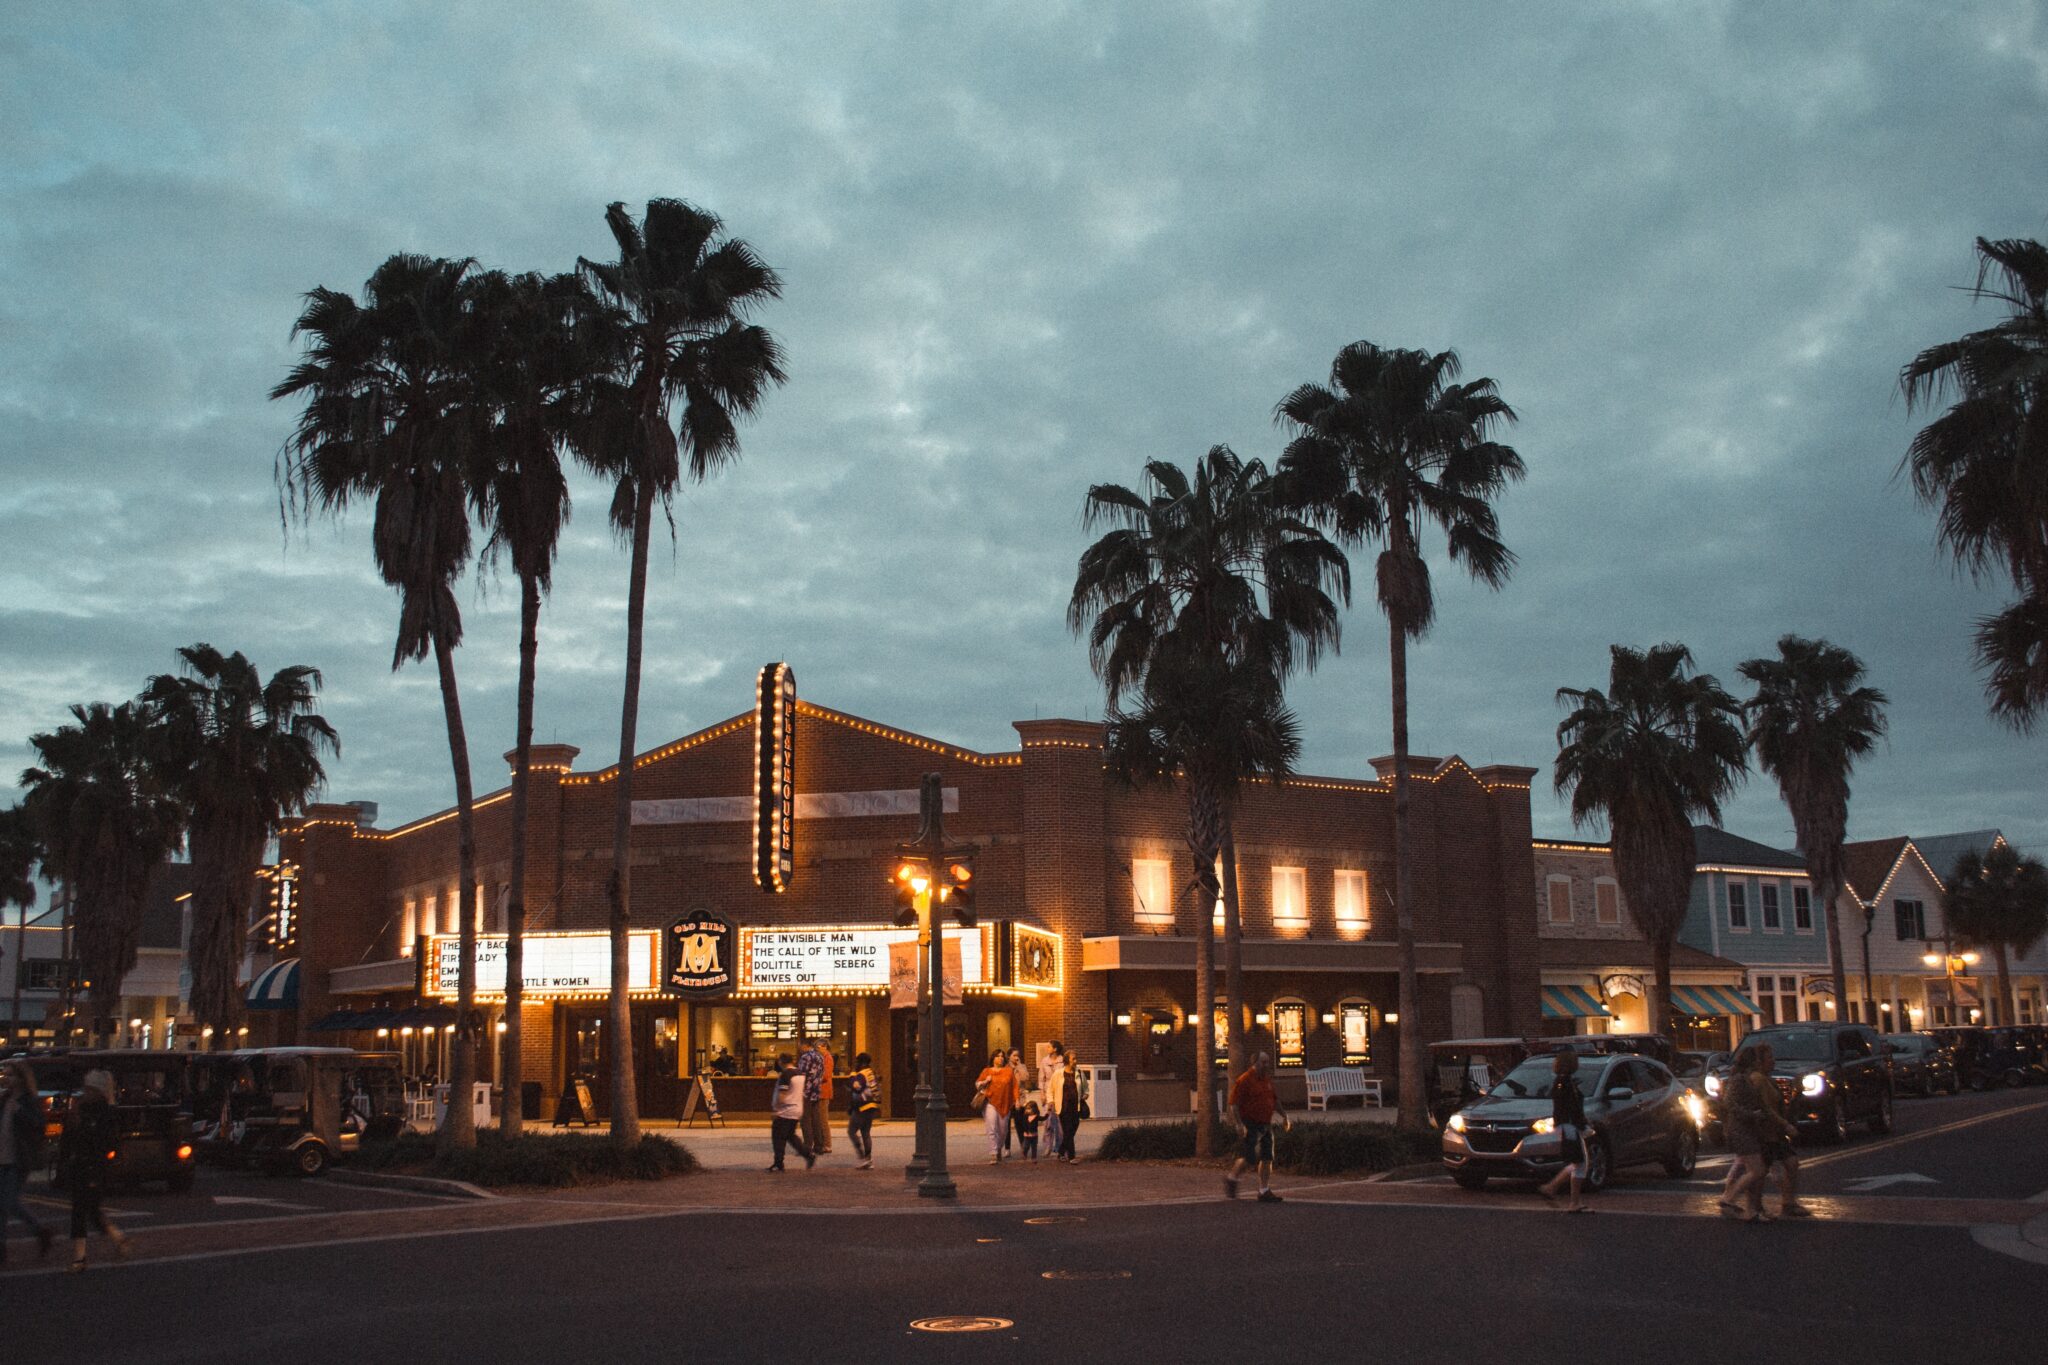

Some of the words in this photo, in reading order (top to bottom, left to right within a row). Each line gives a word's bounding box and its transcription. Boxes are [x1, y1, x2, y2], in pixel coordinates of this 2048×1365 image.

[782, 701, 793, 850] PLAYHOUSE
[674, 923, 696, 934] OLD
[754, 934, 774, 943] THE
[778, 933, 826, 943] INVISIBLE
[831, 933, 854, 942] MAN
[754, 947, 774, 956] THE
[778, 947, 804, 956] CALL
[808, 947, 821, 956] OF
[827, 946, 845, 955] THE
[850, 946, 876, 955] WILD
[476, 954, 498, 963] ADY
[754, 960, 803, 969] DOLITTLE
[834, 959, 875, 969] SEBERG
[553, 977, 590, 986] WOMEN
[671, 973, 729, 987] PLAYHOUSE
[754, 973, 791, 983] KNIVES
[796, 973, 817, 982] OUT
